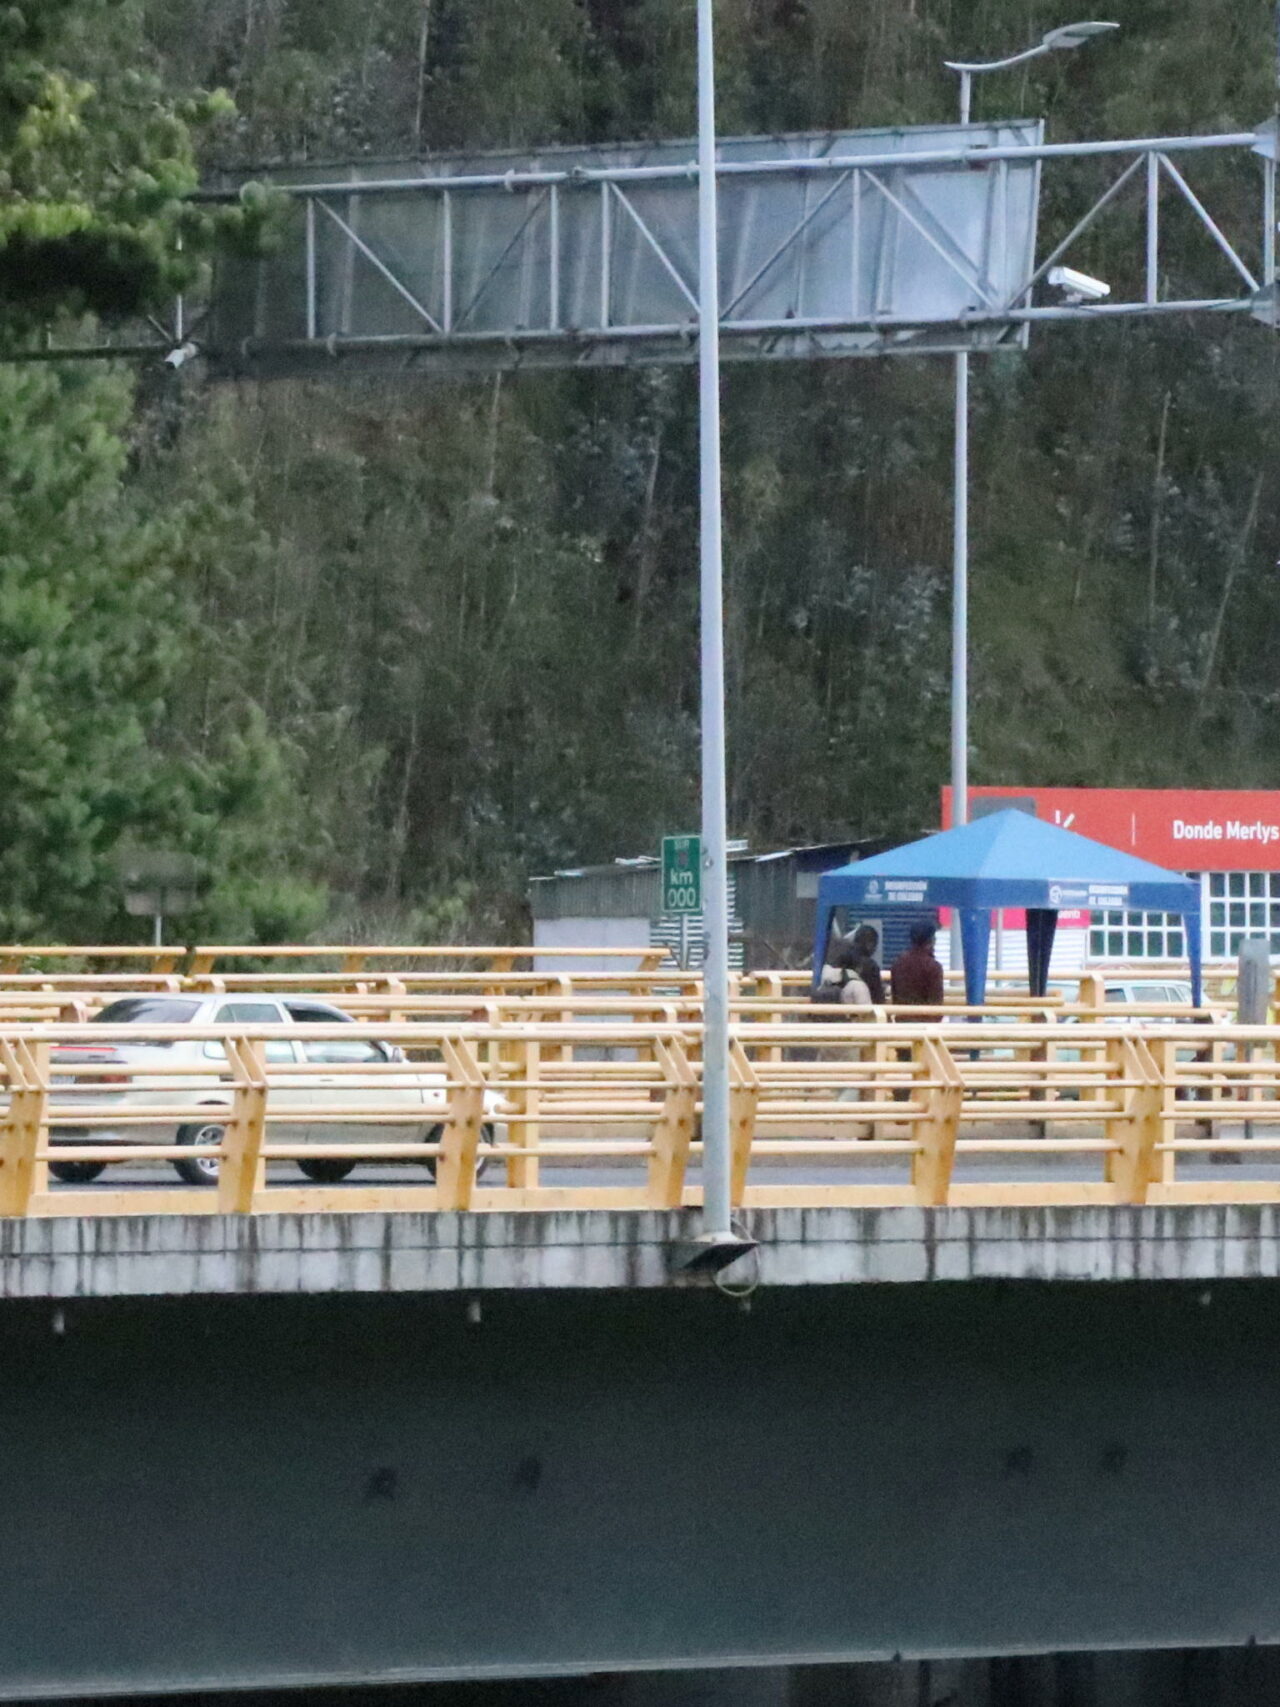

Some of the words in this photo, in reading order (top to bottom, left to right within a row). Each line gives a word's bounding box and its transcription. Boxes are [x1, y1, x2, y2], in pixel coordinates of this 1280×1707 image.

[1172, 819, 1223, 840] Donde
[1226, 819, 1280, 845] Merlys
[670, 867, 694, 886] km
[667, 887, 696, 907] 000
